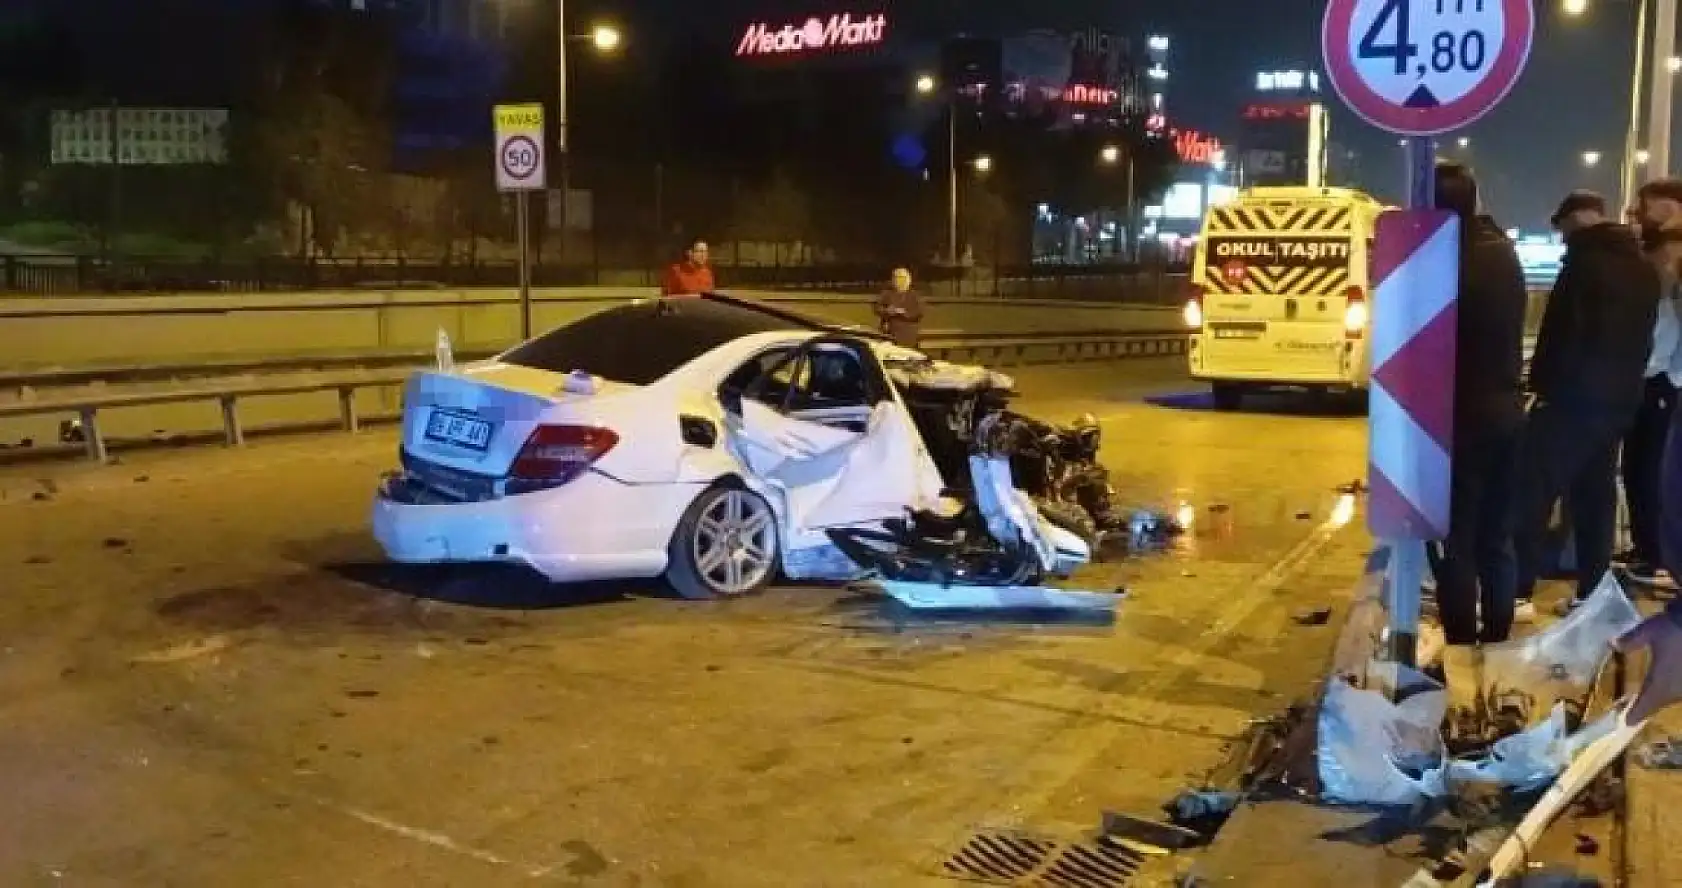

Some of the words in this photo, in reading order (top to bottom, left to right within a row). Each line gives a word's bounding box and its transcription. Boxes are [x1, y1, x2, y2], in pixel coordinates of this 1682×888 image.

[508, 149, 531, 167] 50
[1217, 242, 1273, 256] OKUL
[1279, 242, 1347, 260] TAŞITI
